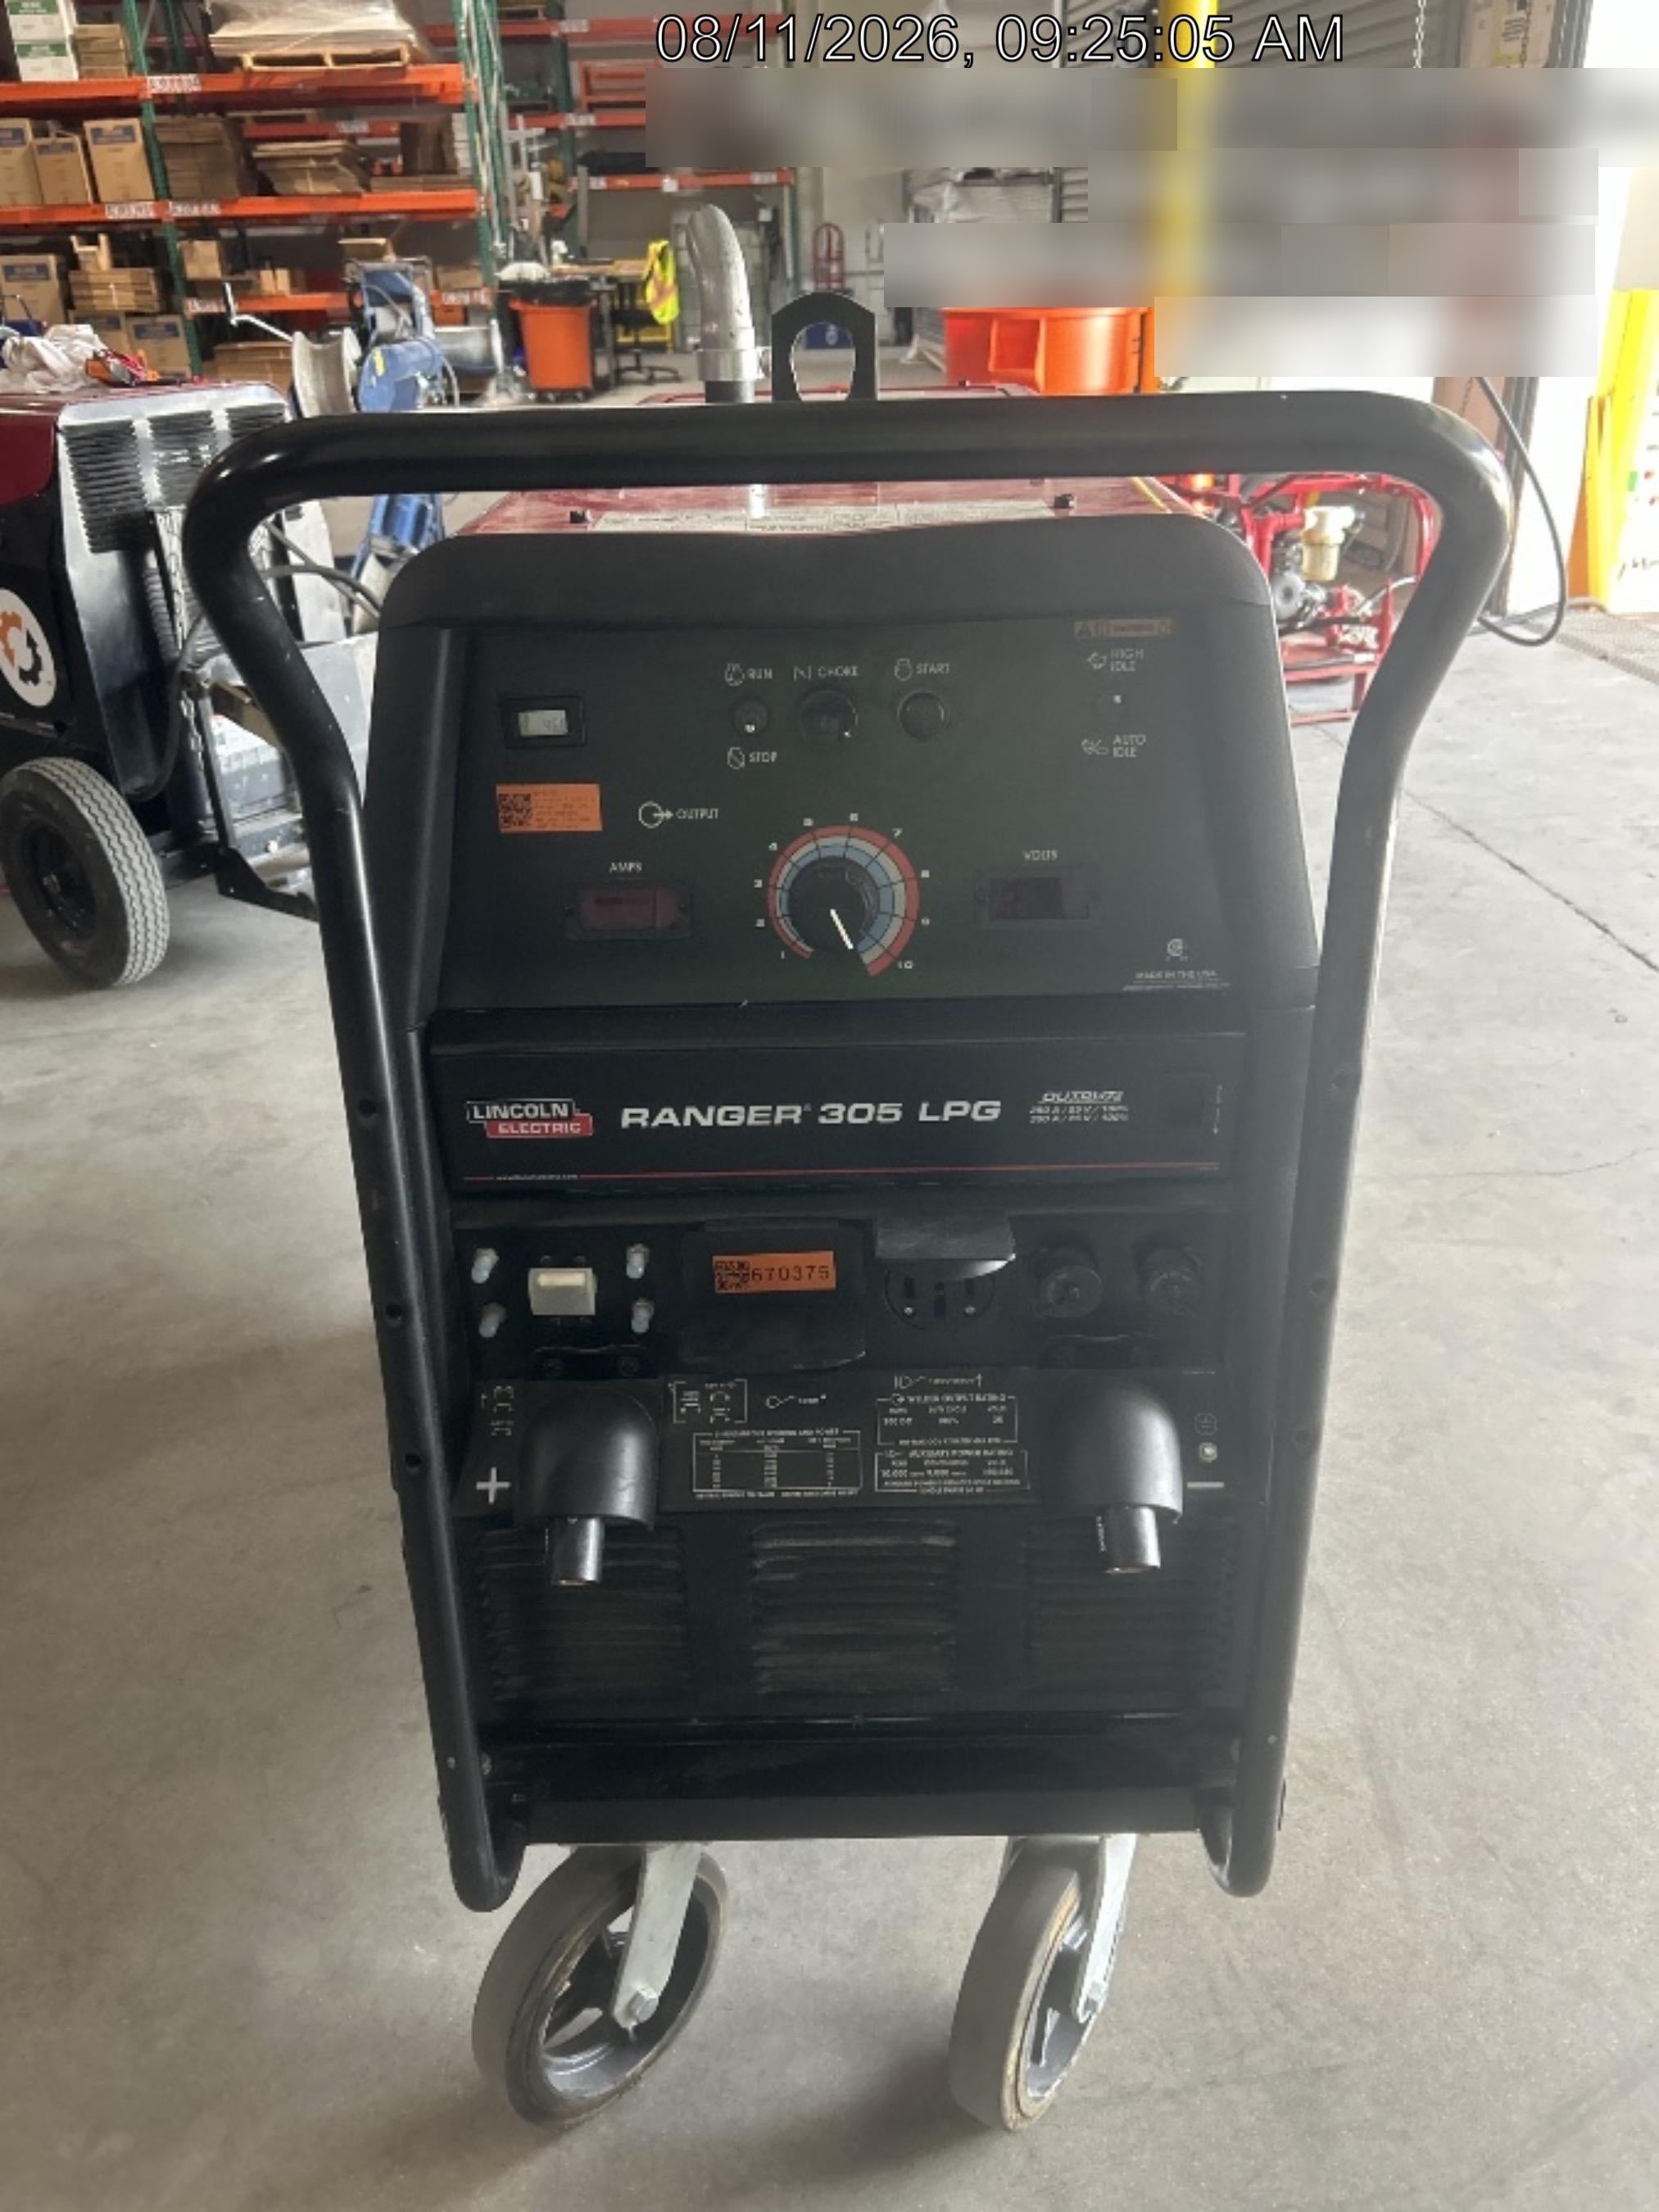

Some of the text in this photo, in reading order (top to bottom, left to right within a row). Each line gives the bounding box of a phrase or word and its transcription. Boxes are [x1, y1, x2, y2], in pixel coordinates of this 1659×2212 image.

[1110, 648, 1144, 660] HIGH
[818, 664, 859, 678] CHOKE
[916, 662, 950, 675] START
[1111, 660, 1136, 672] IDLE
[746, 669, 773, 680] RUN
[1113, 734, 1146, 746] AUTO
[749, 750, 778, 763] STOP
[676, 808, 719, 820] OUTPUT
[1022, 850, 1058, 861] VOLTS
[609, 862, 643, 873] AMPS
[473, 1103, 569, 1119] LINCOLN
[818, 1102, 903, 1125] 305
[918, 1099, 1001, 1122] LPG
[497, 1122, 582, 1135] ELECTRIC
[751, 1265, 830, 1282] 670375
